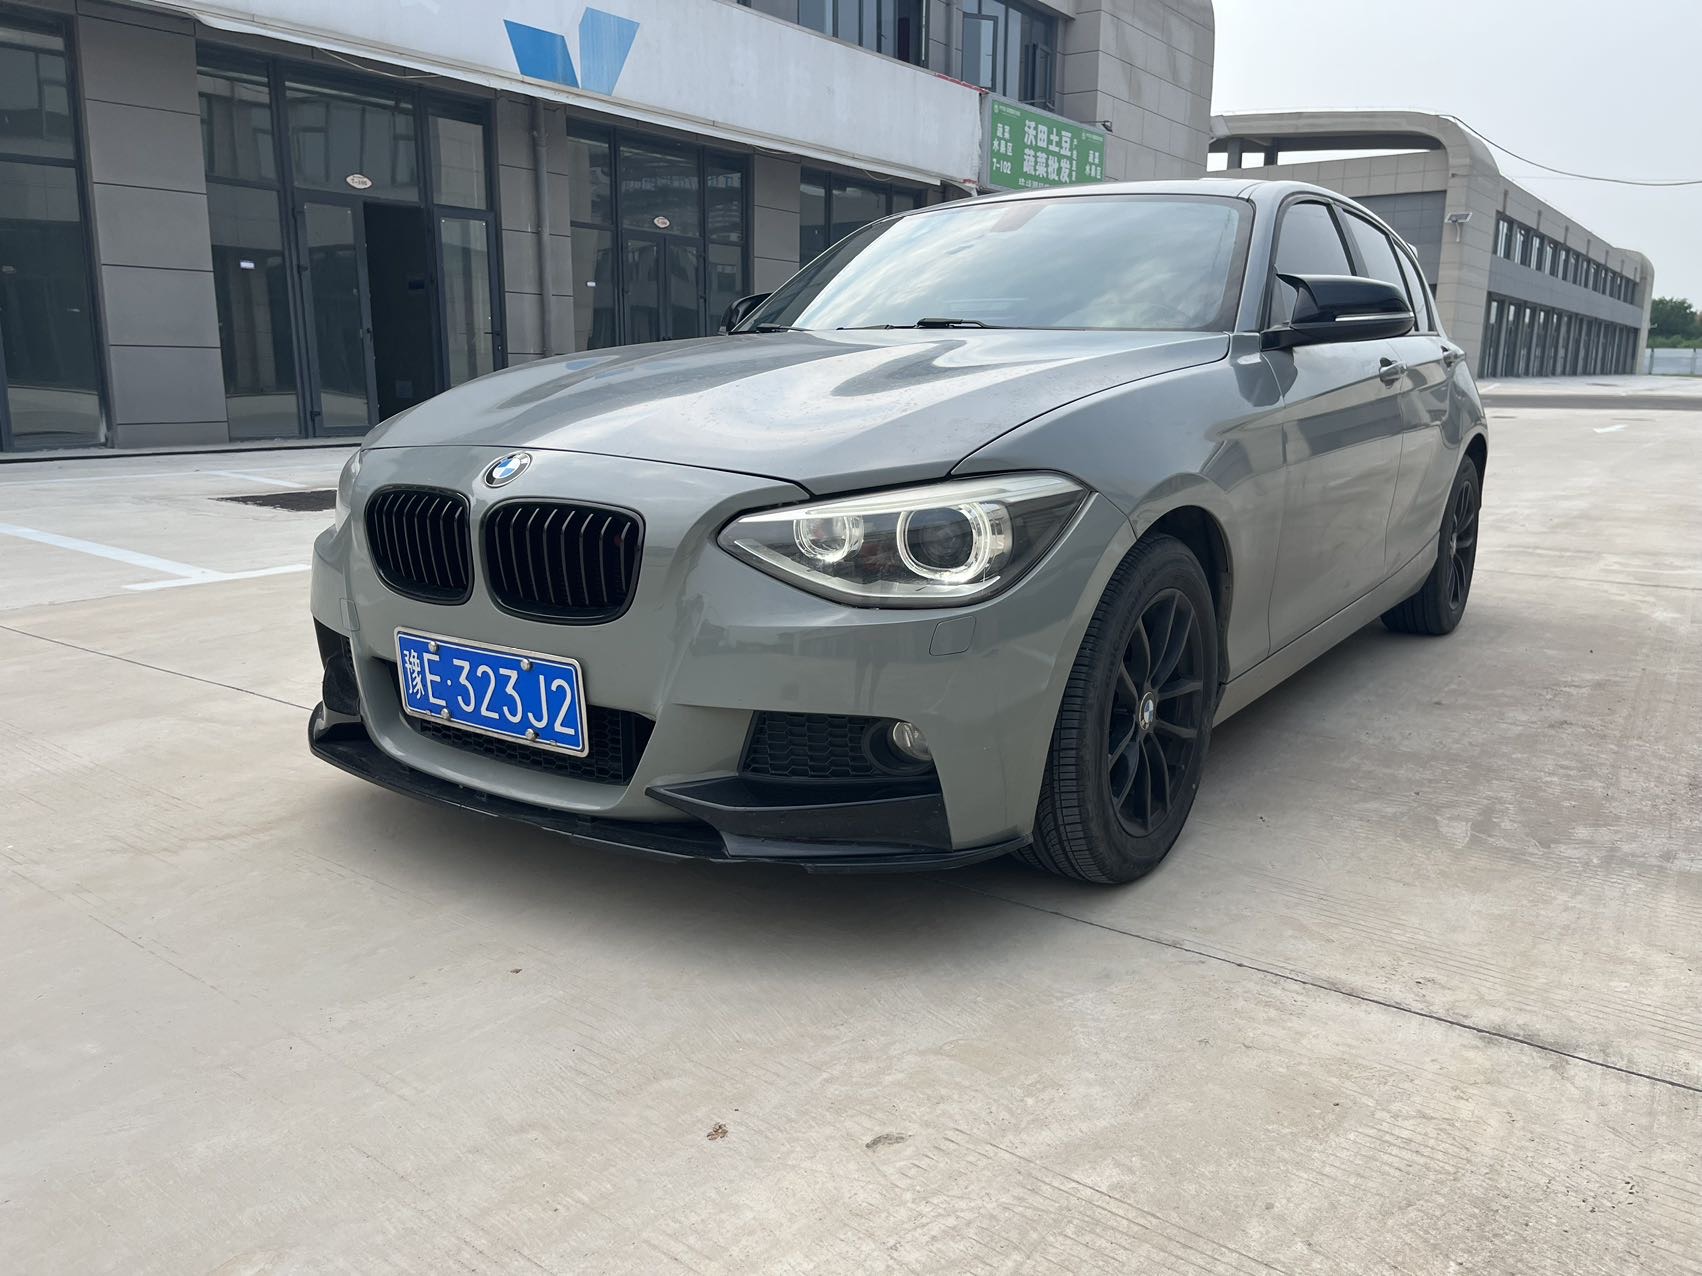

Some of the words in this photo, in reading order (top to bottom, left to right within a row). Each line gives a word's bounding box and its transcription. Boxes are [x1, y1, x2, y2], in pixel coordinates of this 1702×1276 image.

[1024, 119, 1072, 157] 沃田土豆
[992, 158, 1012, 175] 7-102
[1023, 148, 1071, 183] 蔬菜批发
